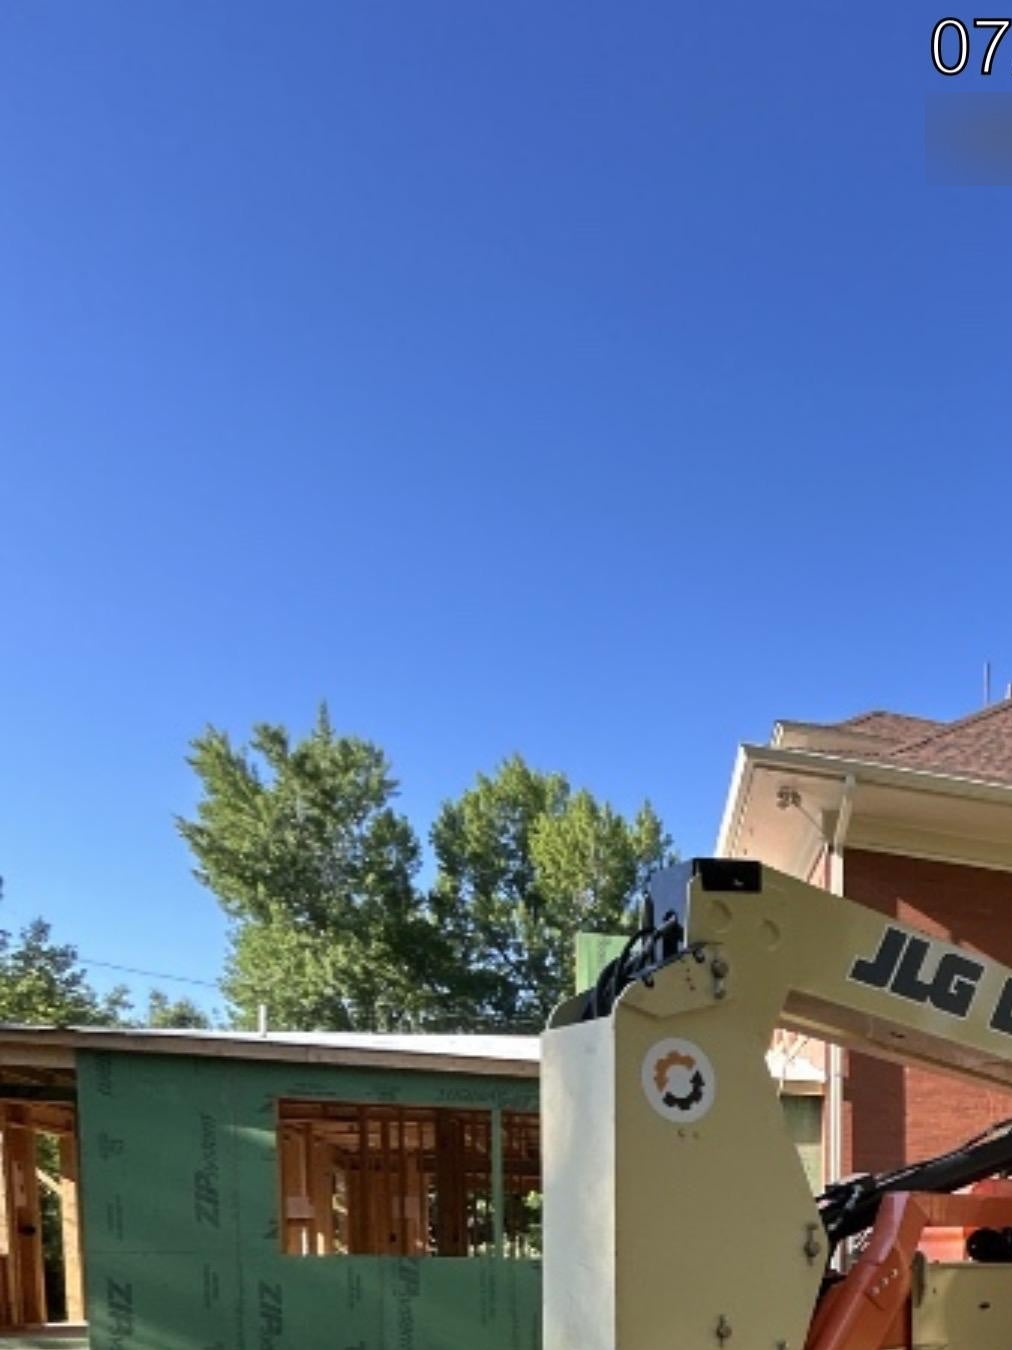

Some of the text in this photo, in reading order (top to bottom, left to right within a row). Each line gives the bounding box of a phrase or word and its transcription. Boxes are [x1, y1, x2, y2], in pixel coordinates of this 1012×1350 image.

[849, 926, 985, 1018] JLG
[194, 1169, 220, 1230] ZIP
[259, 1280, 283, 1335] ZIP
